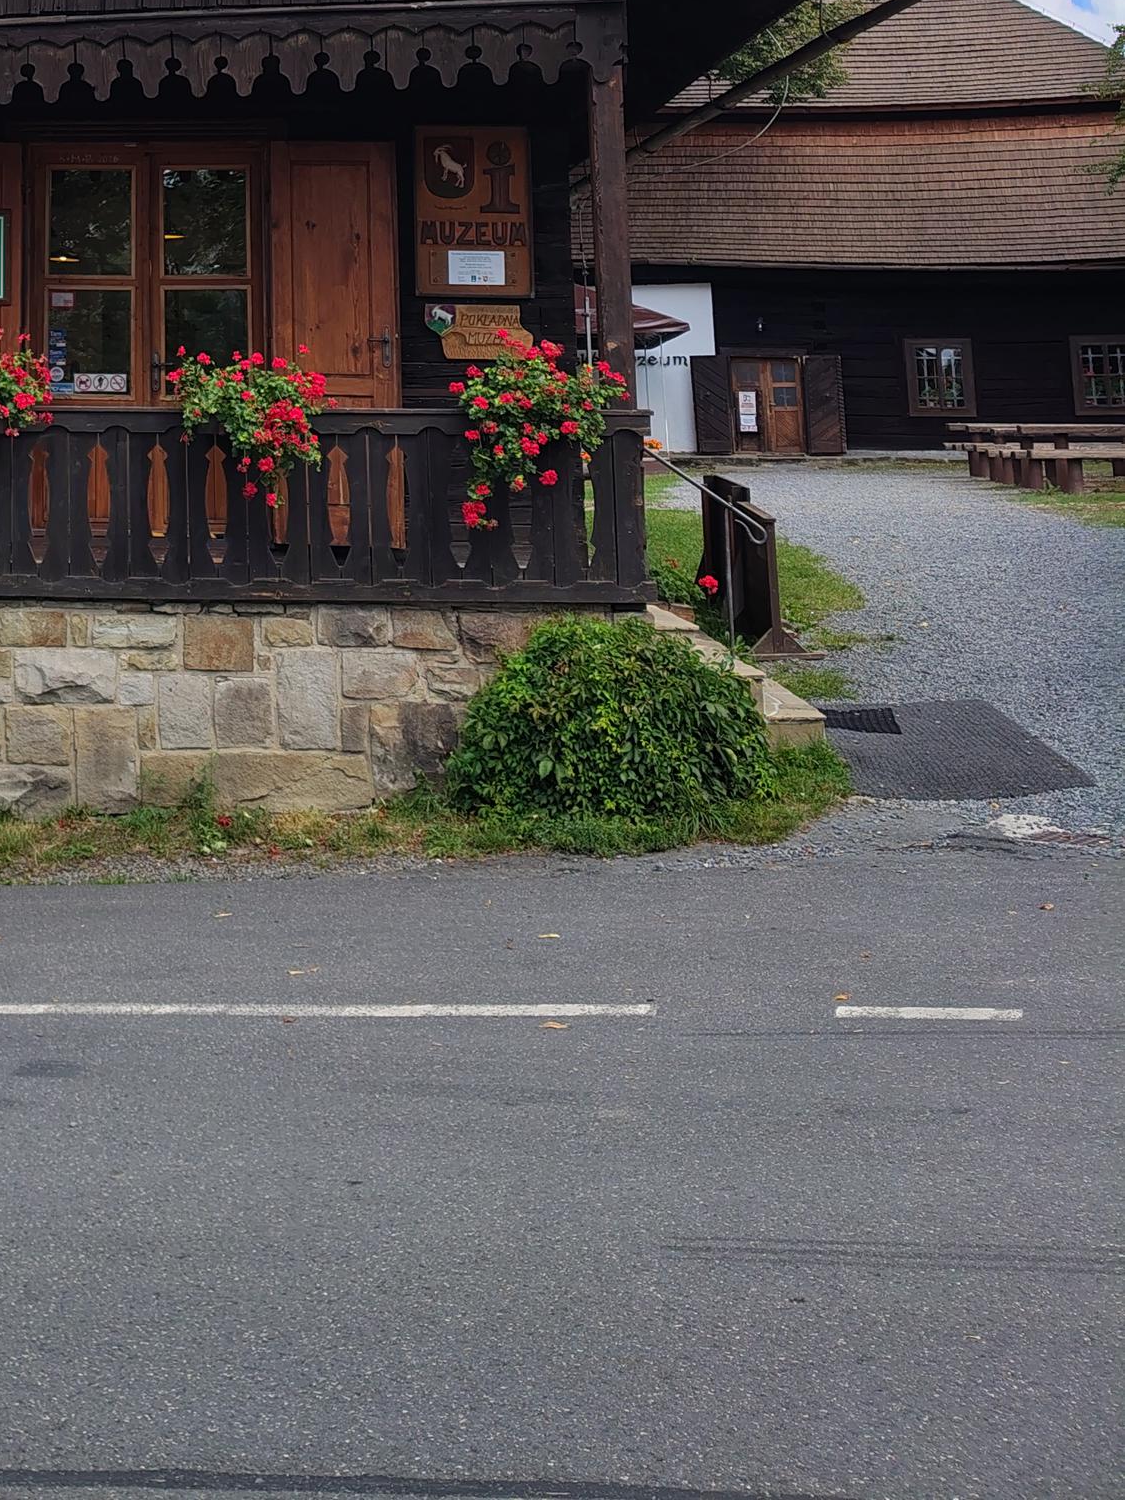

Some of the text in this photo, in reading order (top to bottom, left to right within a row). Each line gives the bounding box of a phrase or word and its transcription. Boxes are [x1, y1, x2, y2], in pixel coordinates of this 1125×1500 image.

[420, 221, 527, 246] MUZEUM
[459, 314, 520, 327] POKLADNA
[636, 355, 688, 367] zeum
